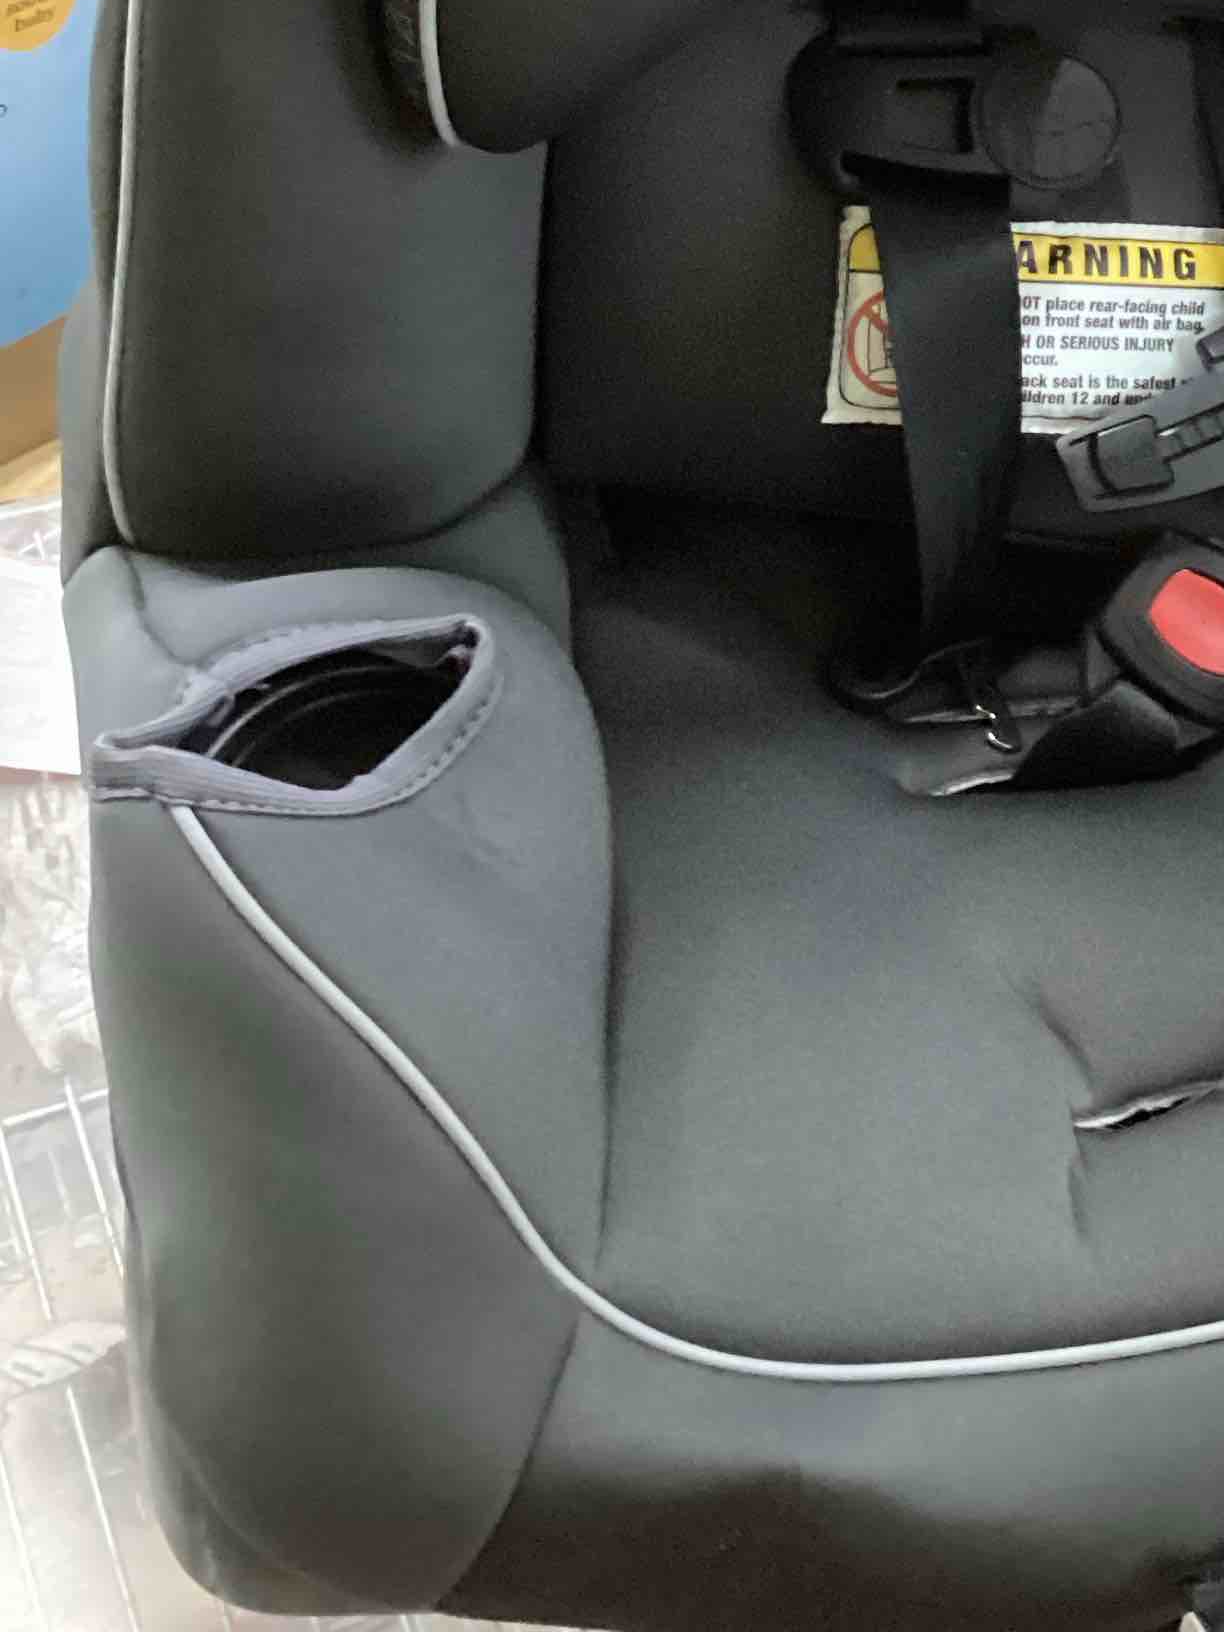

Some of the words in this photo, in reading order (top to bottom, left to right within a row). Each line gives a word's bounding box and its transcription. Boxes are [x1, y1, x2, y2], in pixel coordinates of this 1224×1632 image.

[1016, 240, 1197, 281] ARNING
[1022, 295, 1041, 310] OT
[1045, 297, 1085, 314] place
[1090, 299, 1167, 318] rear-facing
[1171, 300, 1206, 316] child
[1022, 315, 1040, 327] on
[1045, 313, 1080, 328] front
[1085, 316, 1114, 329] seat
[1119, 316, 1149, 330] with
[1153, 318, 1171, 330] air
[1037, 335, 1055, 349] OR
[1060, 336, 1120, 351] SERIOUS
[1124, 337, 1174, 353] INJURY
[1023, 354, 1059, 367] ccur.
[1021, 374, 1047, 388] ack
[1053, 376, 1083, 389] seat
[1088, 376, 1101, 389] is
[1106, 376, 1128, 389] the
[1133, 376, 1176, 390] safest
[1021, 390, 1065, 405] ildren
[1071, 392, 1089, 405] 12
[1093, 392, 1120, 406] and
